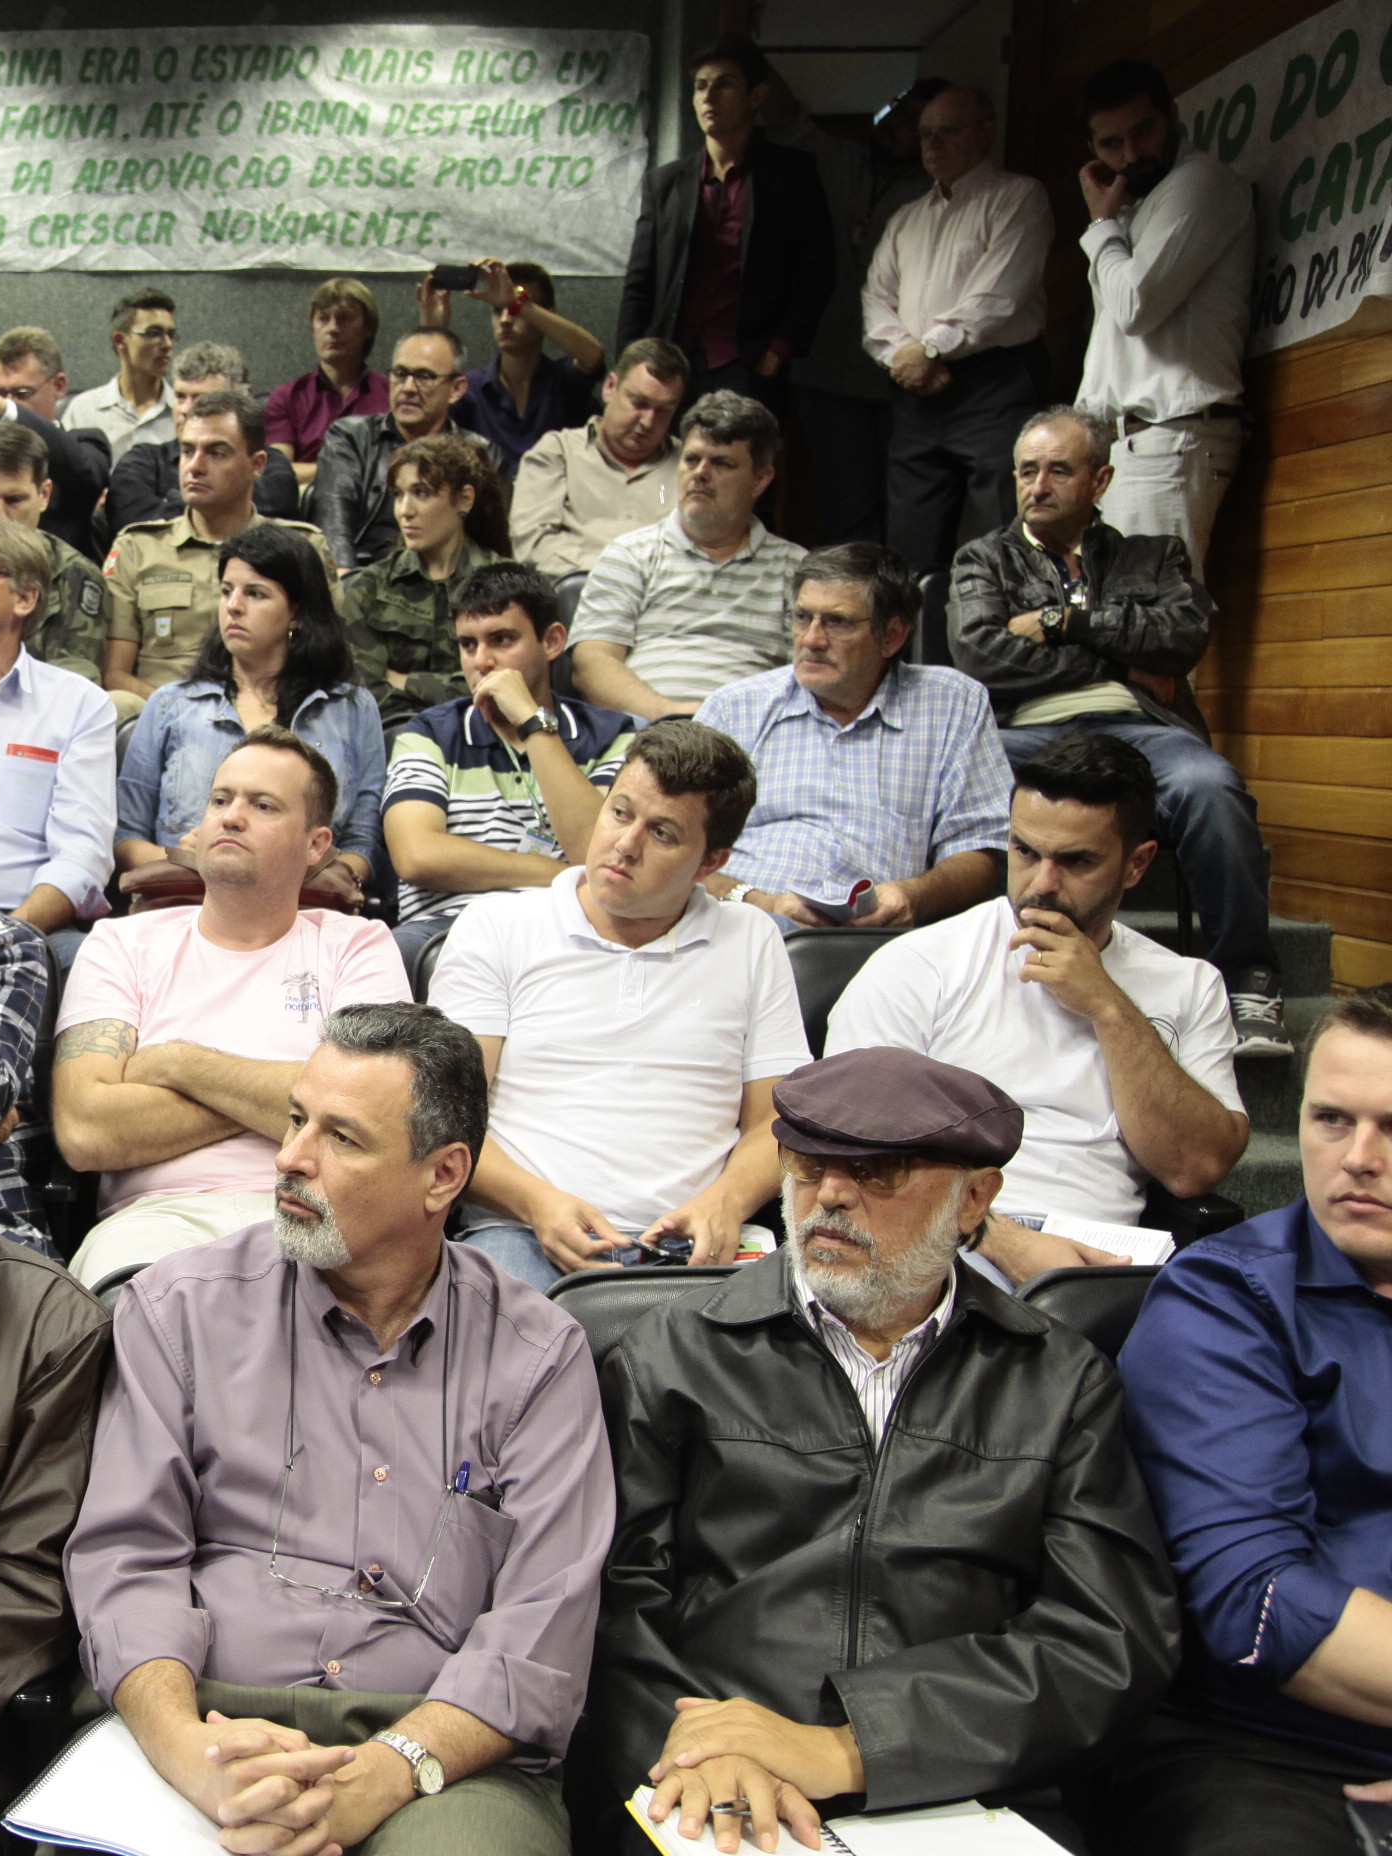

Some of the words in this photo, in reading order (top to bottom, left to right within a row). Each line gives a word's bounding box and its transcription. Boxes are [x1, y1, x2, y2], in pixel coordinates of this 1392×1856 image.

[78, 46, 140, 84] ERA
[154, 45, 178, 81] O
[191, 45, 319, 83] ESTADO
[336, 47, 433, 84] MAIS
[451, 50, 537, 84] RICO
[557, 50, 610, 84] EM
[1271, 29, 1360, 143] DO
[141, 92, 207, 139] ATÉ
[218, 101, 242, 135] O
[258, 100, 370, 137] IBAMA
[11, 159, 53, 195] DA
[74, 149, 292, 197] APROVAÇÃO
[308, 155, 418, 188] DESSE
[433, 155, 595, 191] PROJETO
[28, 211, 176, 248] CRESCER
[199, 203, 447, 248] NOVAMENTE.
